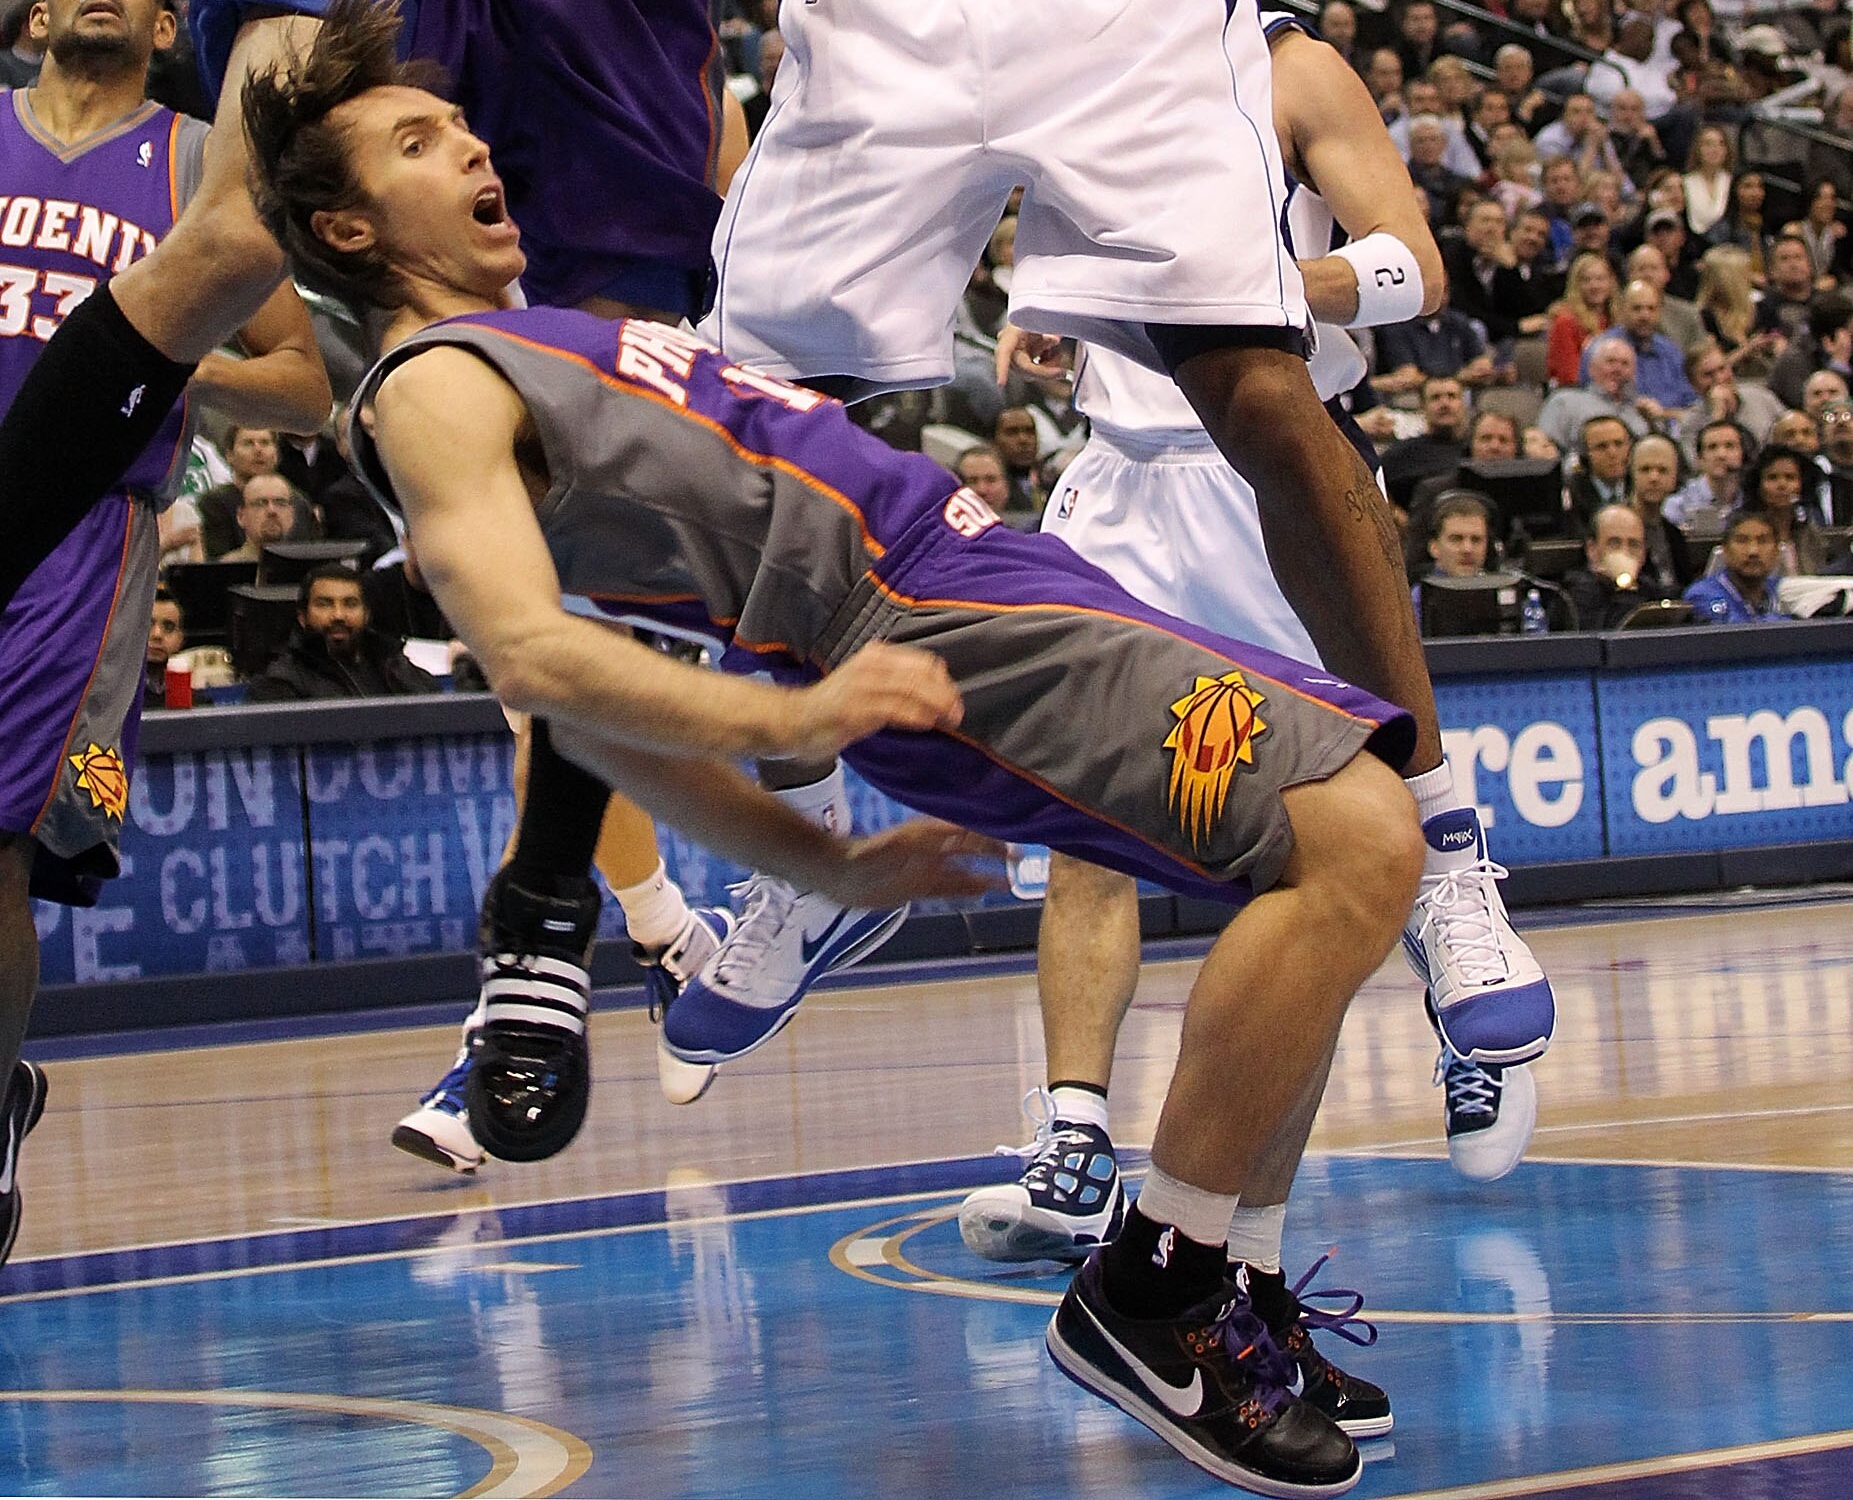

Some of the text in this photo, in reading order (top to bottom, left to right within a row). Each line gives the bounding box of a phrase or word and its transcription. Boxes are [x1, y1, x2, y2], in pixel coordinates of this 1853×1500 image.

[0, 195, 158, 274] OENI
[1375, 267, 1405, 288] 2
[1632, 705, 1853, 824] am
[160, 832, 447, 935] CLUTCH
